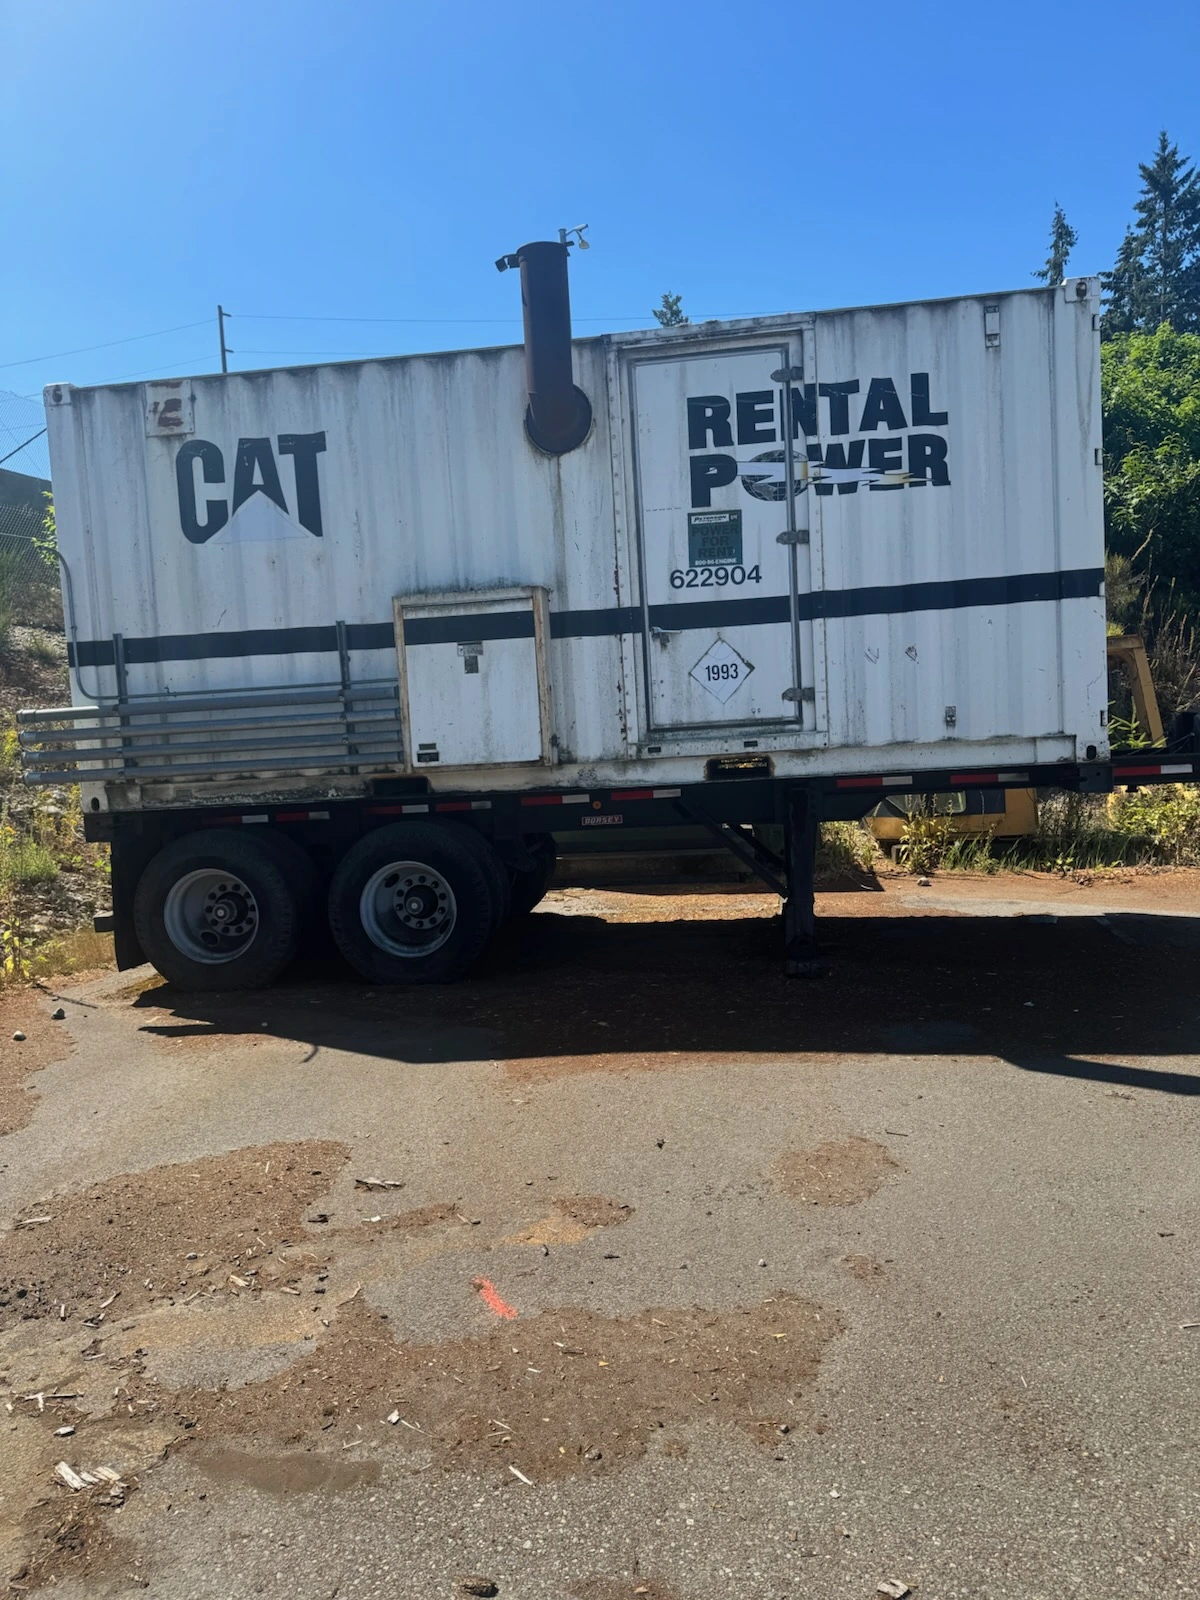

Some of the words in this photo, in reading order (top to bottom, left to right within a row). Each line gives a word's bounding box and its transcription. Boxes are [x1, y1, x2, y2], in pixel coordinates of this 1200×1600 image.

[687, 373, 949, 449] RENTAL
[690, 434, 951, 508] POWER
[176, 431, 327, 544] CAT
[692, 525, 738, 537] POWER
[702, 536, 729, 547] FOR
[698, 546, 734, 558] RENT
[670, 565, 762, 589] 622904
[705, 663, 739, 681] 1993
